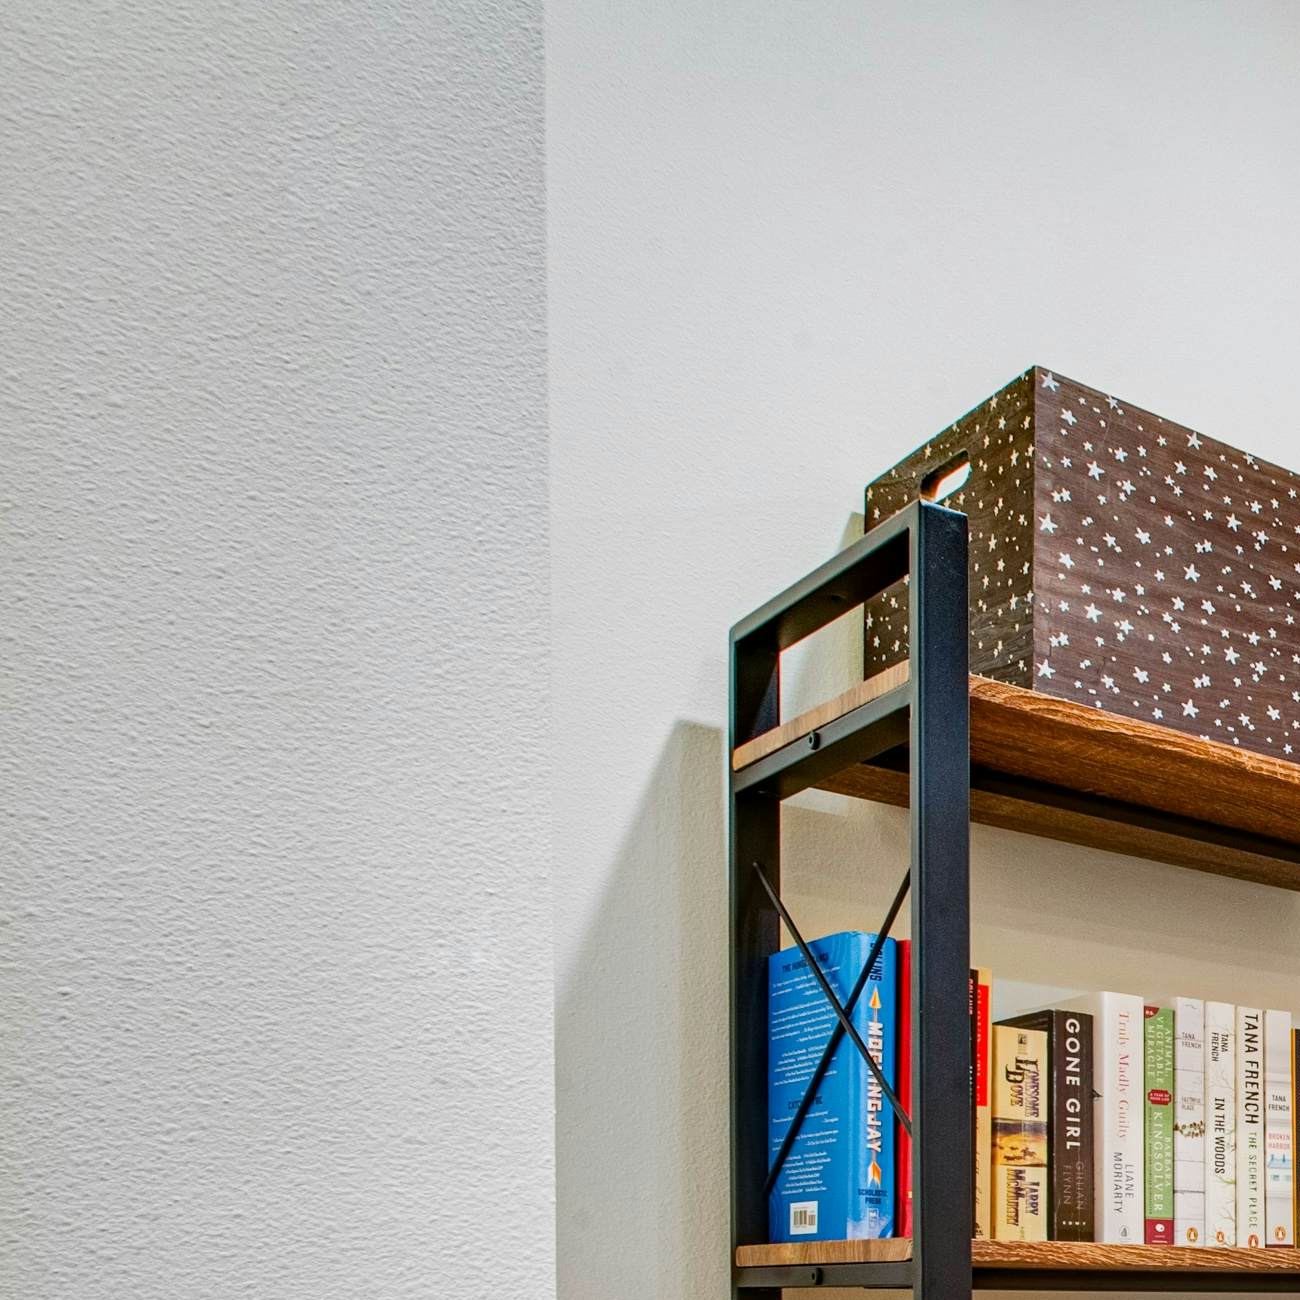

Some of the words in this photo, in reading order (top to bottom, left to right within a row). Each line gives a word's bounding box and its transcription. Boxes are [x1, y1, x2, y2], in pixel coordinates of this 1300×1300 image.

[1118, 1012, 1130, 1048] Truly
[1211, 1031, 1220, 1062] FRENCH
[1220, 1033, 1229, 1053] TANA
[1244, 1013, 1259, 1053] TANA
[1065, 1018, 1081, 1086] GONE
[1118, 1054, 1130, 1093] Madly
[1244, 1060, 1259, 1124] FRENCH
[1118, 1099, 1129, 1140] Guilty
[1214, 1097, 1226, 1111] IN
[1065, 1097, 1081, 1150] GIRL
[1214, 1114, 1226, 1133] THE
[1248, 1131, 1258, 1149] THE
[1152, 1111, 1163, 1211] KINGSOLVER
[1214, 1135, 1226, 1174] WOODS
[1248, 1154, 1258, 1191] SECRET
[1112, 1151, 1123, 1214] MORIARTY
[1124, 1164, 1135, 1199] LIANE
[1248, 1197, 1258, 1229] PLACE
